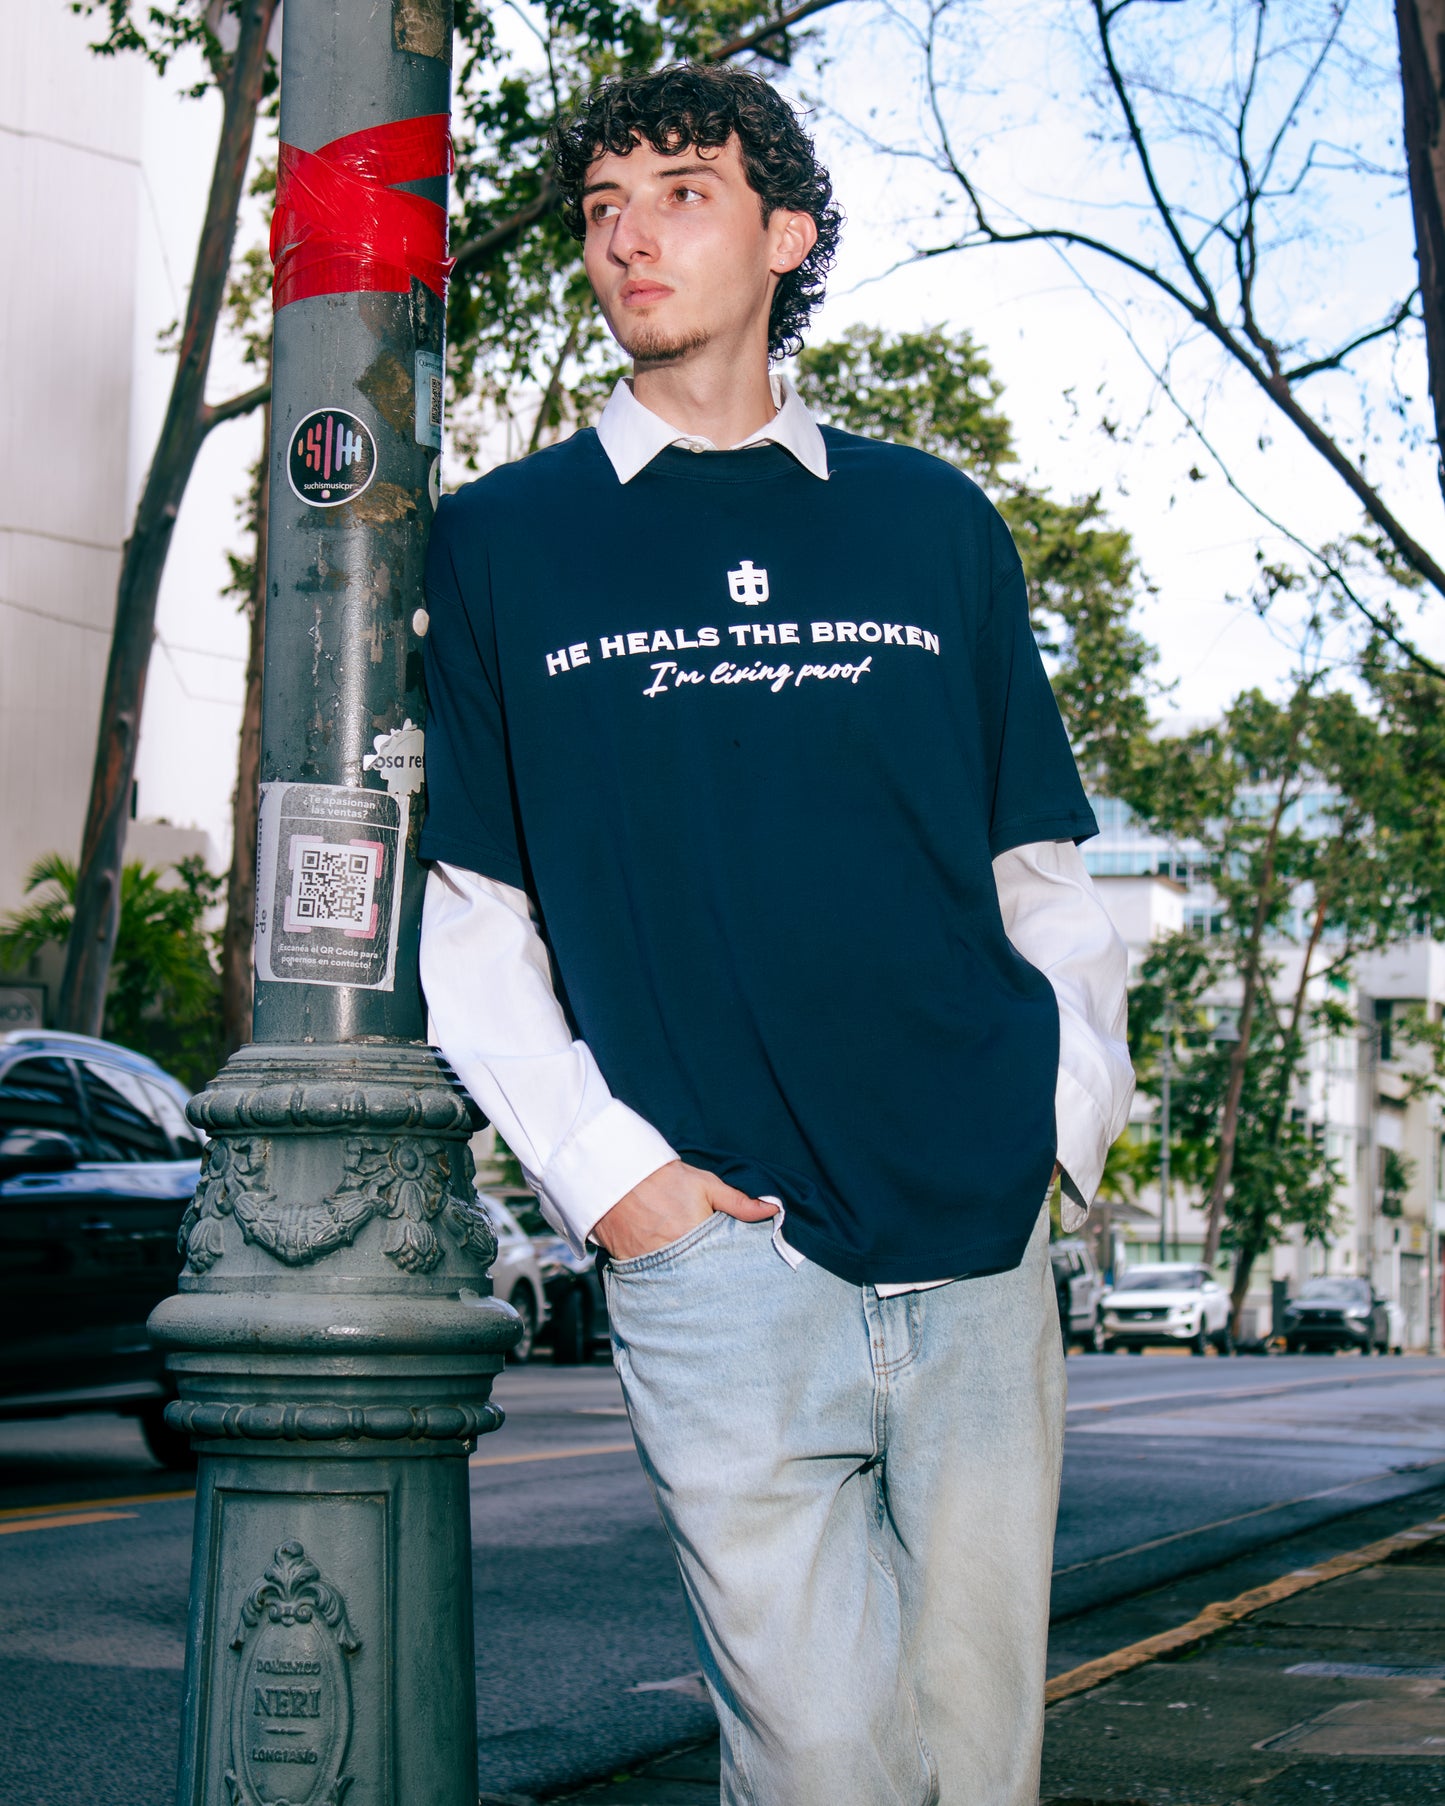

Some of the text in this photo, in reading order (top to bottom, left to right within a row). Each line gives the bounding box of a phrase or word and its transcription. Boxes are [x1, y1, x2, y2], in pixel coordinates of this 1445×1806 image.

[303, 481, 353, 491] suchismusicpr
[545, 621, 940, 677] HE HEALS THE BROKEN
[642, 655, 873, 698] I'm living proof
[322, 797, 376, 809] apasionan
[311, 805, 369, 819] las ventas?
[310, 946, 319, 954] el
[319, 946, 334, 956] QR
[335, 947, 359, 957] Code
[360, 950, 379, 960] para
[330, 959, 372, 970] contacto!
[252, 1687, 321, 1718] NERI
[252, 1748, 318, 1764] LONGIANO
